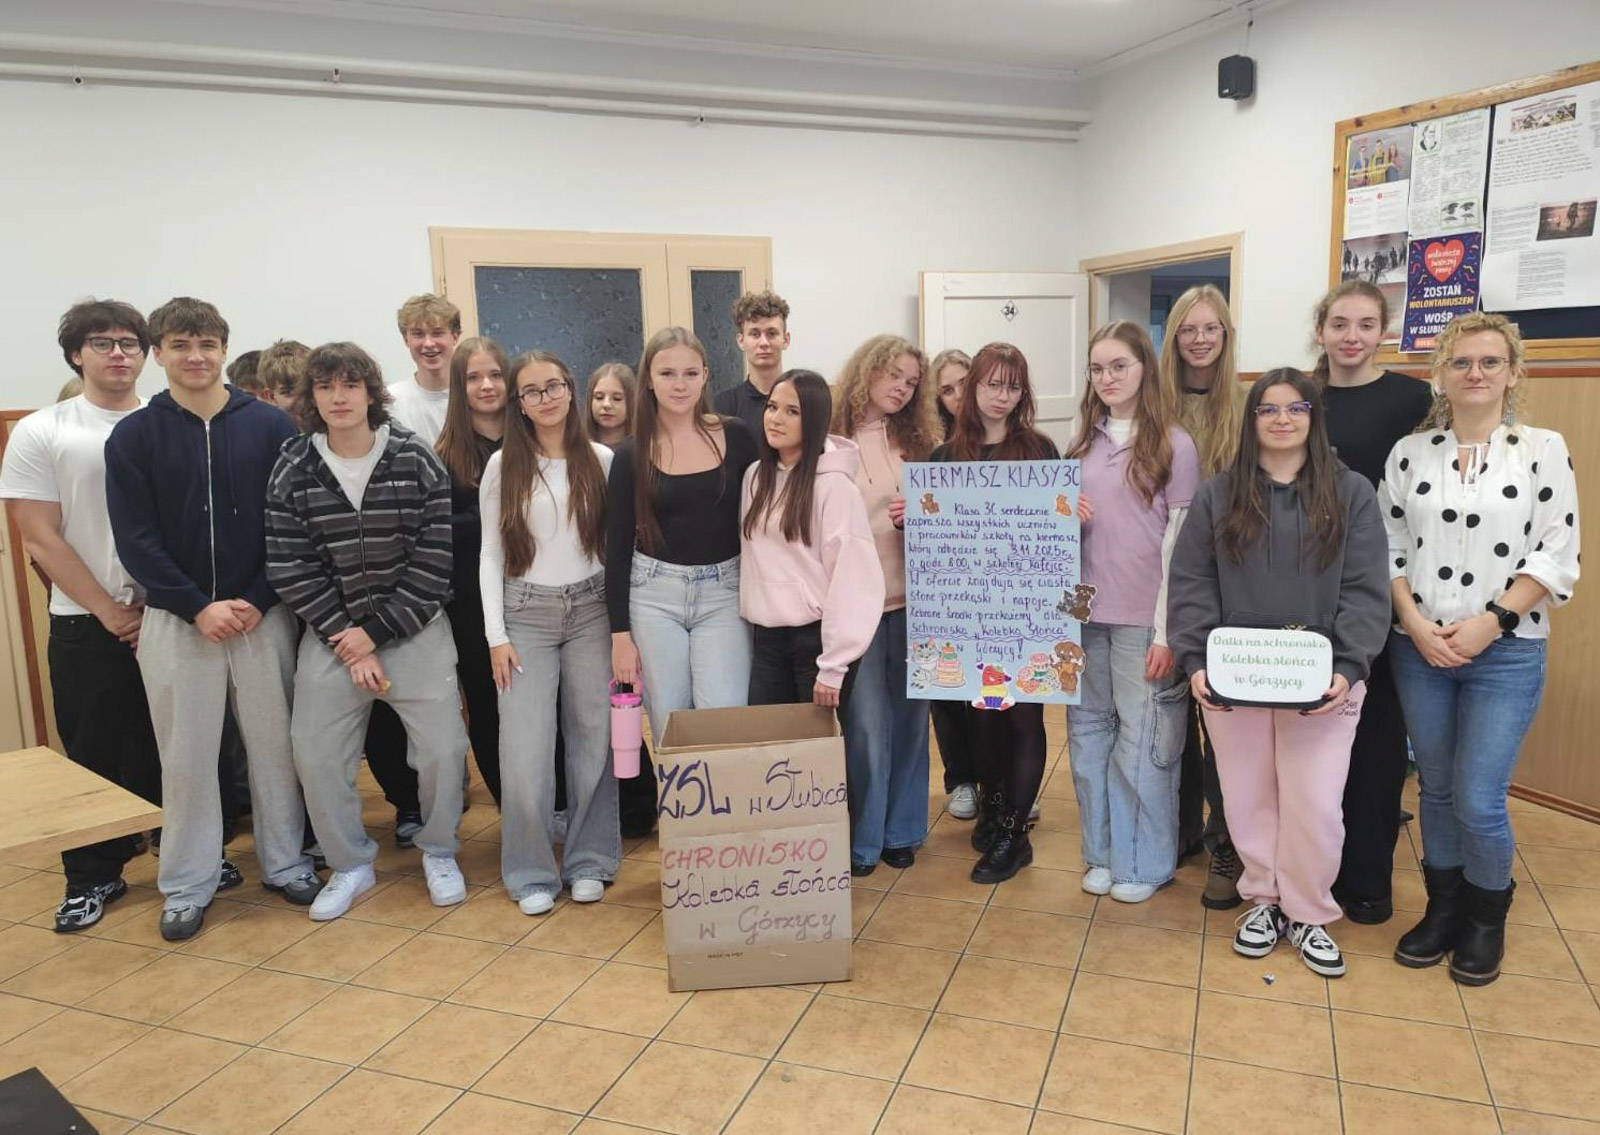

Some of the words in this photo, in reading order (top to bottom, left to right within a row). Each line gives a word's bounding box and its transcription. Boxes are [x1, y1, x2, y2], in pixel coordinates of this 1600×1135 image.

[1424, 282, 1462, 298] ZOSTAŃ
[1424, 310, 1454, 324] WOŚP
[1410, 326, 1419, 335] W
[909, 464, 1002, 489] KIERMASZ
[1008, 464, 1060, 487] KLASY
[1063, 464, 1080, 487] 3C
[954, 502, 980, 515] Klasa
[984, 501, 997, 515] 3C
[1000, 505, 1050, 516] serdecznie
[907, 517, 952, 530] zaprasza
[957, 517, 1011, 532] wszystkich
[1017, 517, 1057, 530] uczniów
[918, 530, 977, 543] pracowników
[983, 531, 1014, 546] szkoły
[1019, 533, 1032, 541] na
[908, 541, 931, 557] który
[937, 541, 978, 556] odbędzie
[985, 546, 998, 558] się
[973, 559, 982, 567] w
[986, 558, 1022, 571] szkolnej
[926, 574, 962, 588] ofercie
[967, 574, 1014, 592] znajdują
[1019, 579, 1033, 591] się
[939, 588, 992, 608] przekąski
[909, 606, 942, 619] Zebrane
[975, 609, 1032, 627] przekażemy
[1043, 610, 1063, 621] dla
[1212, 635, 1243, 647] Datki
[1246, 639, 1261, 647] na
[1263, 638, 1327, 649] schronisko
[1221, 653, 1271, 666] Kolebka
[1273, 655, 1317, 667] słońca
[1234, 676, 1245, 684] w
[1248, 675, 1304, 690] Górzycy
[658, 759, 732, 820] ZSL
[662, 871, 761, 910] Kolebka
[737, 904, 838, 946] Górzycy
